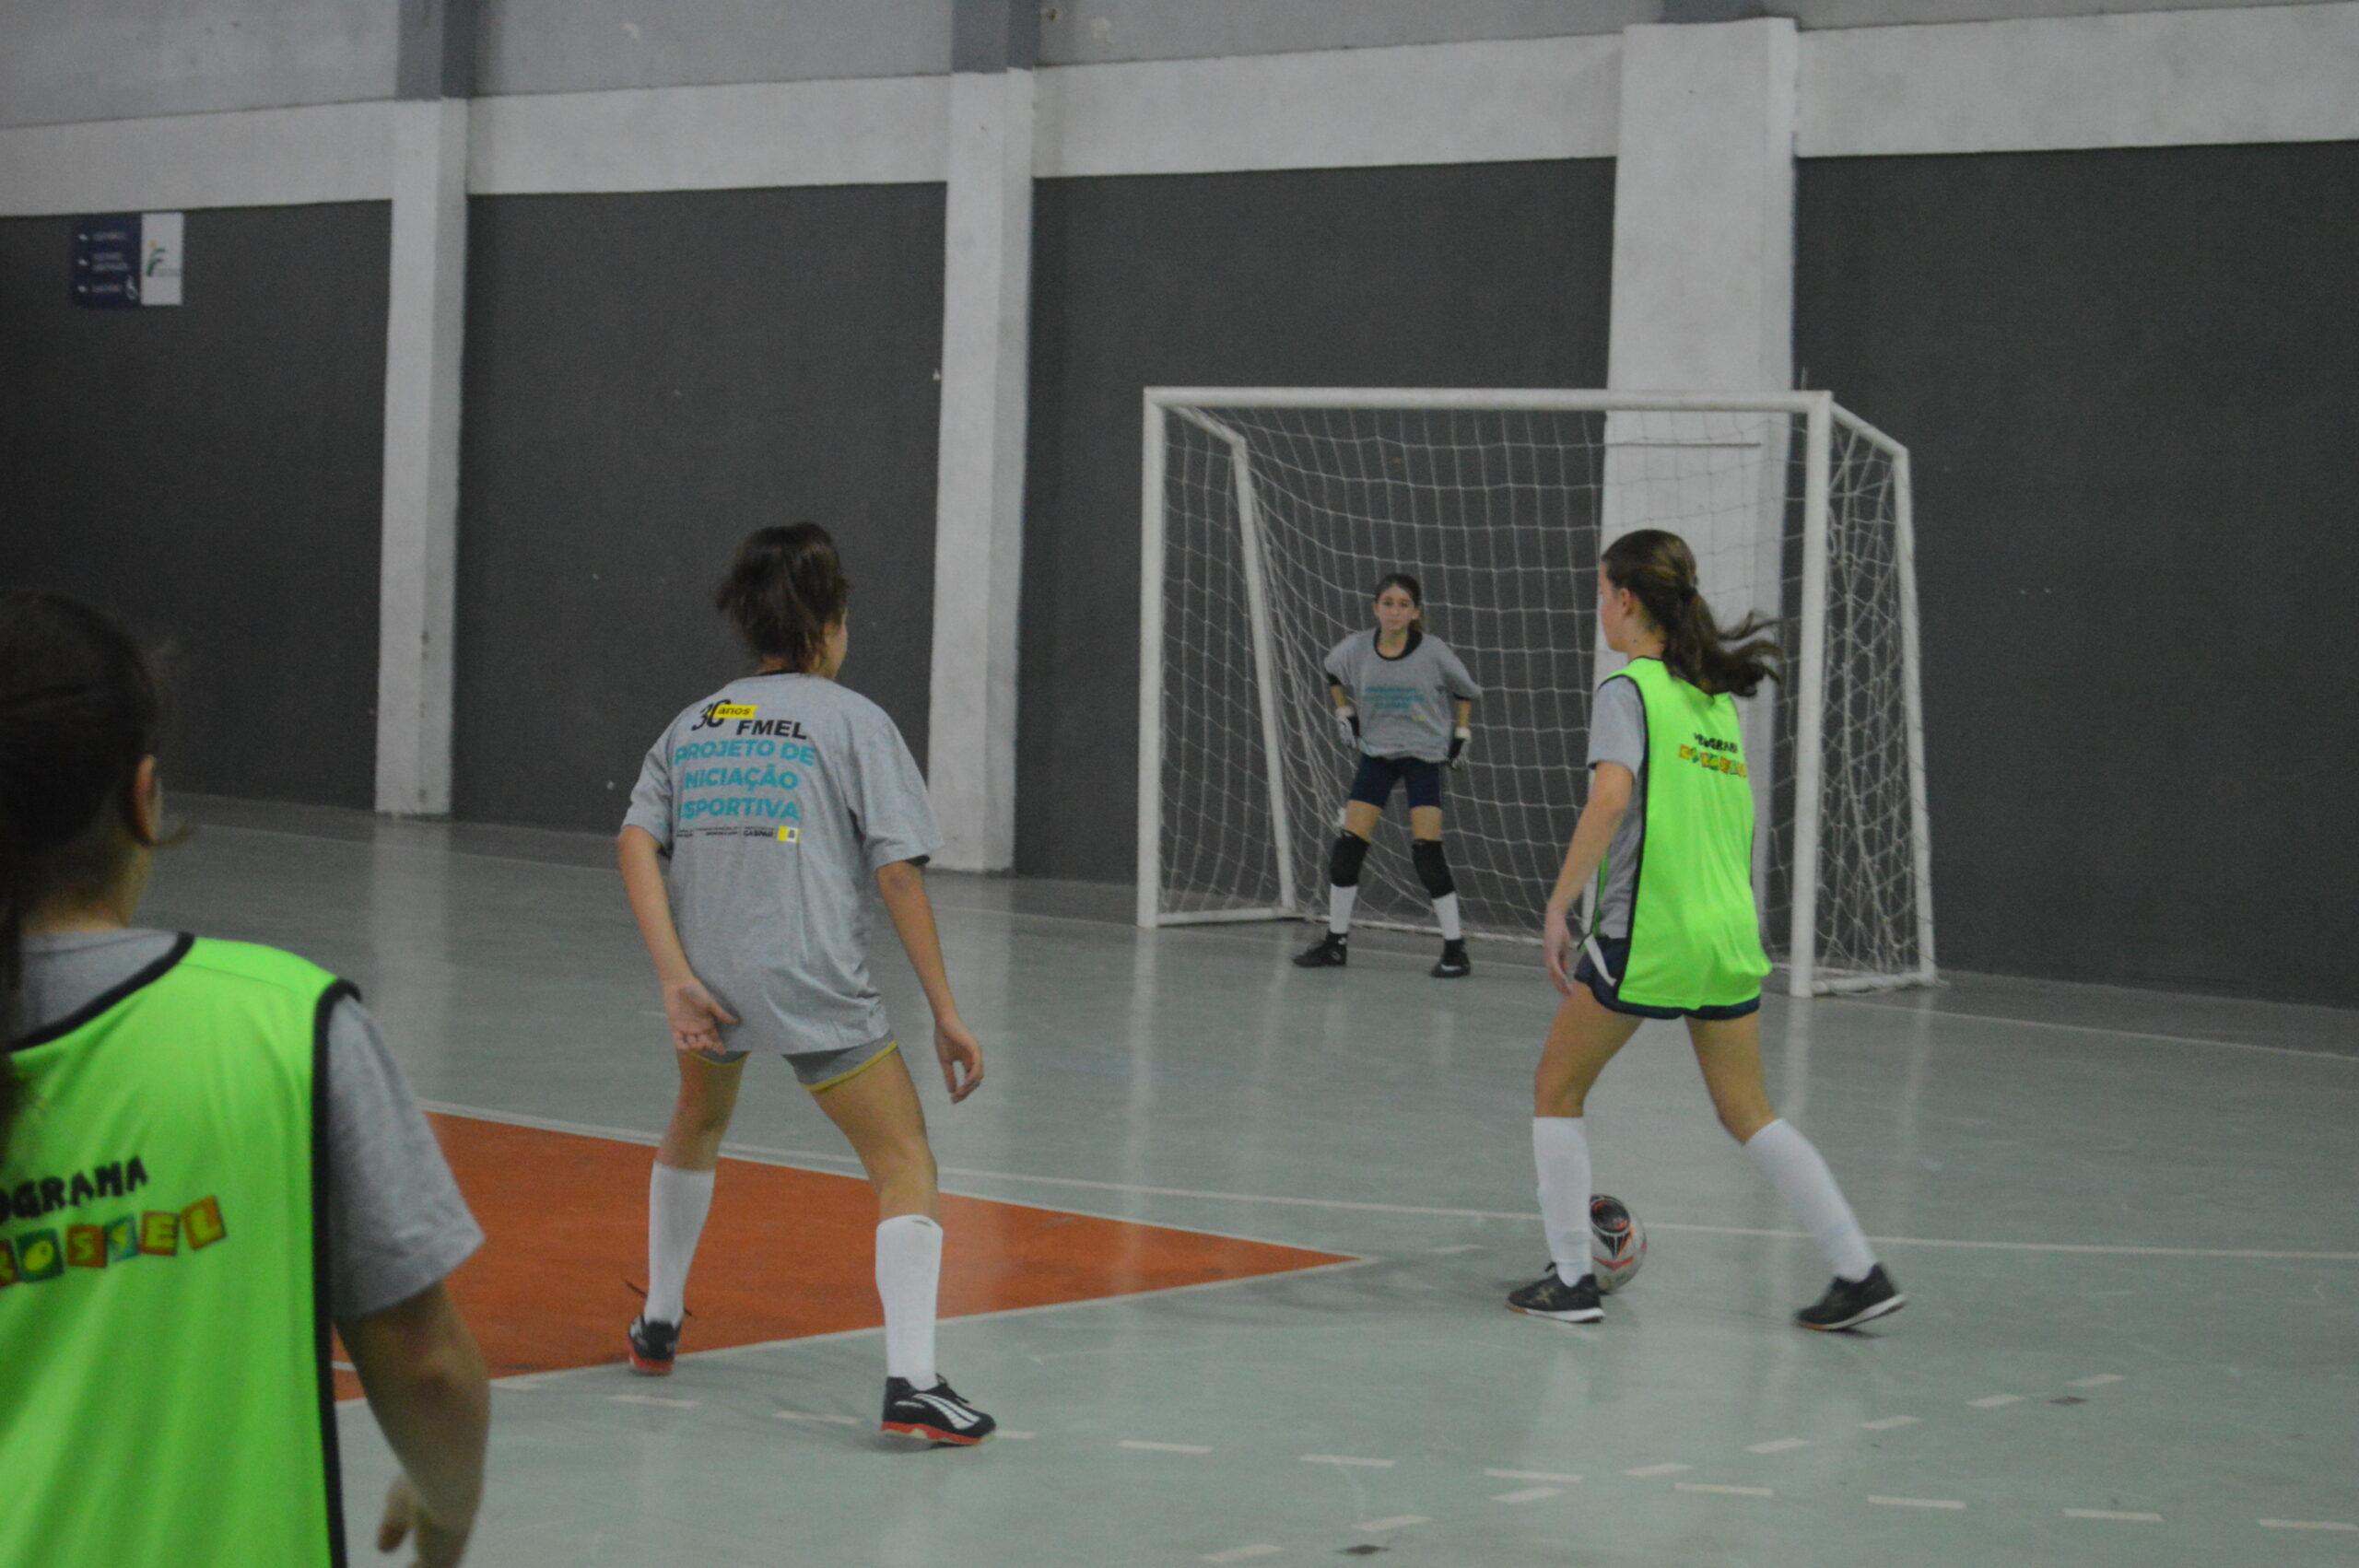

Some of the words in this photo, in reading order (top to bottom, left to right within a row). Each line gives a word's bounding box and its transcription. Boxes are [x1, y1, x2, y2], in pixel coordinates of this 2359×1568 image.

[736, 720, 807, 740] FMEL
[675, 740, 775, 766] PROJETO
[780, 743, 816, 766] DE
[683, 764, 799, 791] NICIAÇÃO
[678, 798, 799, 822] SPORTIVA
